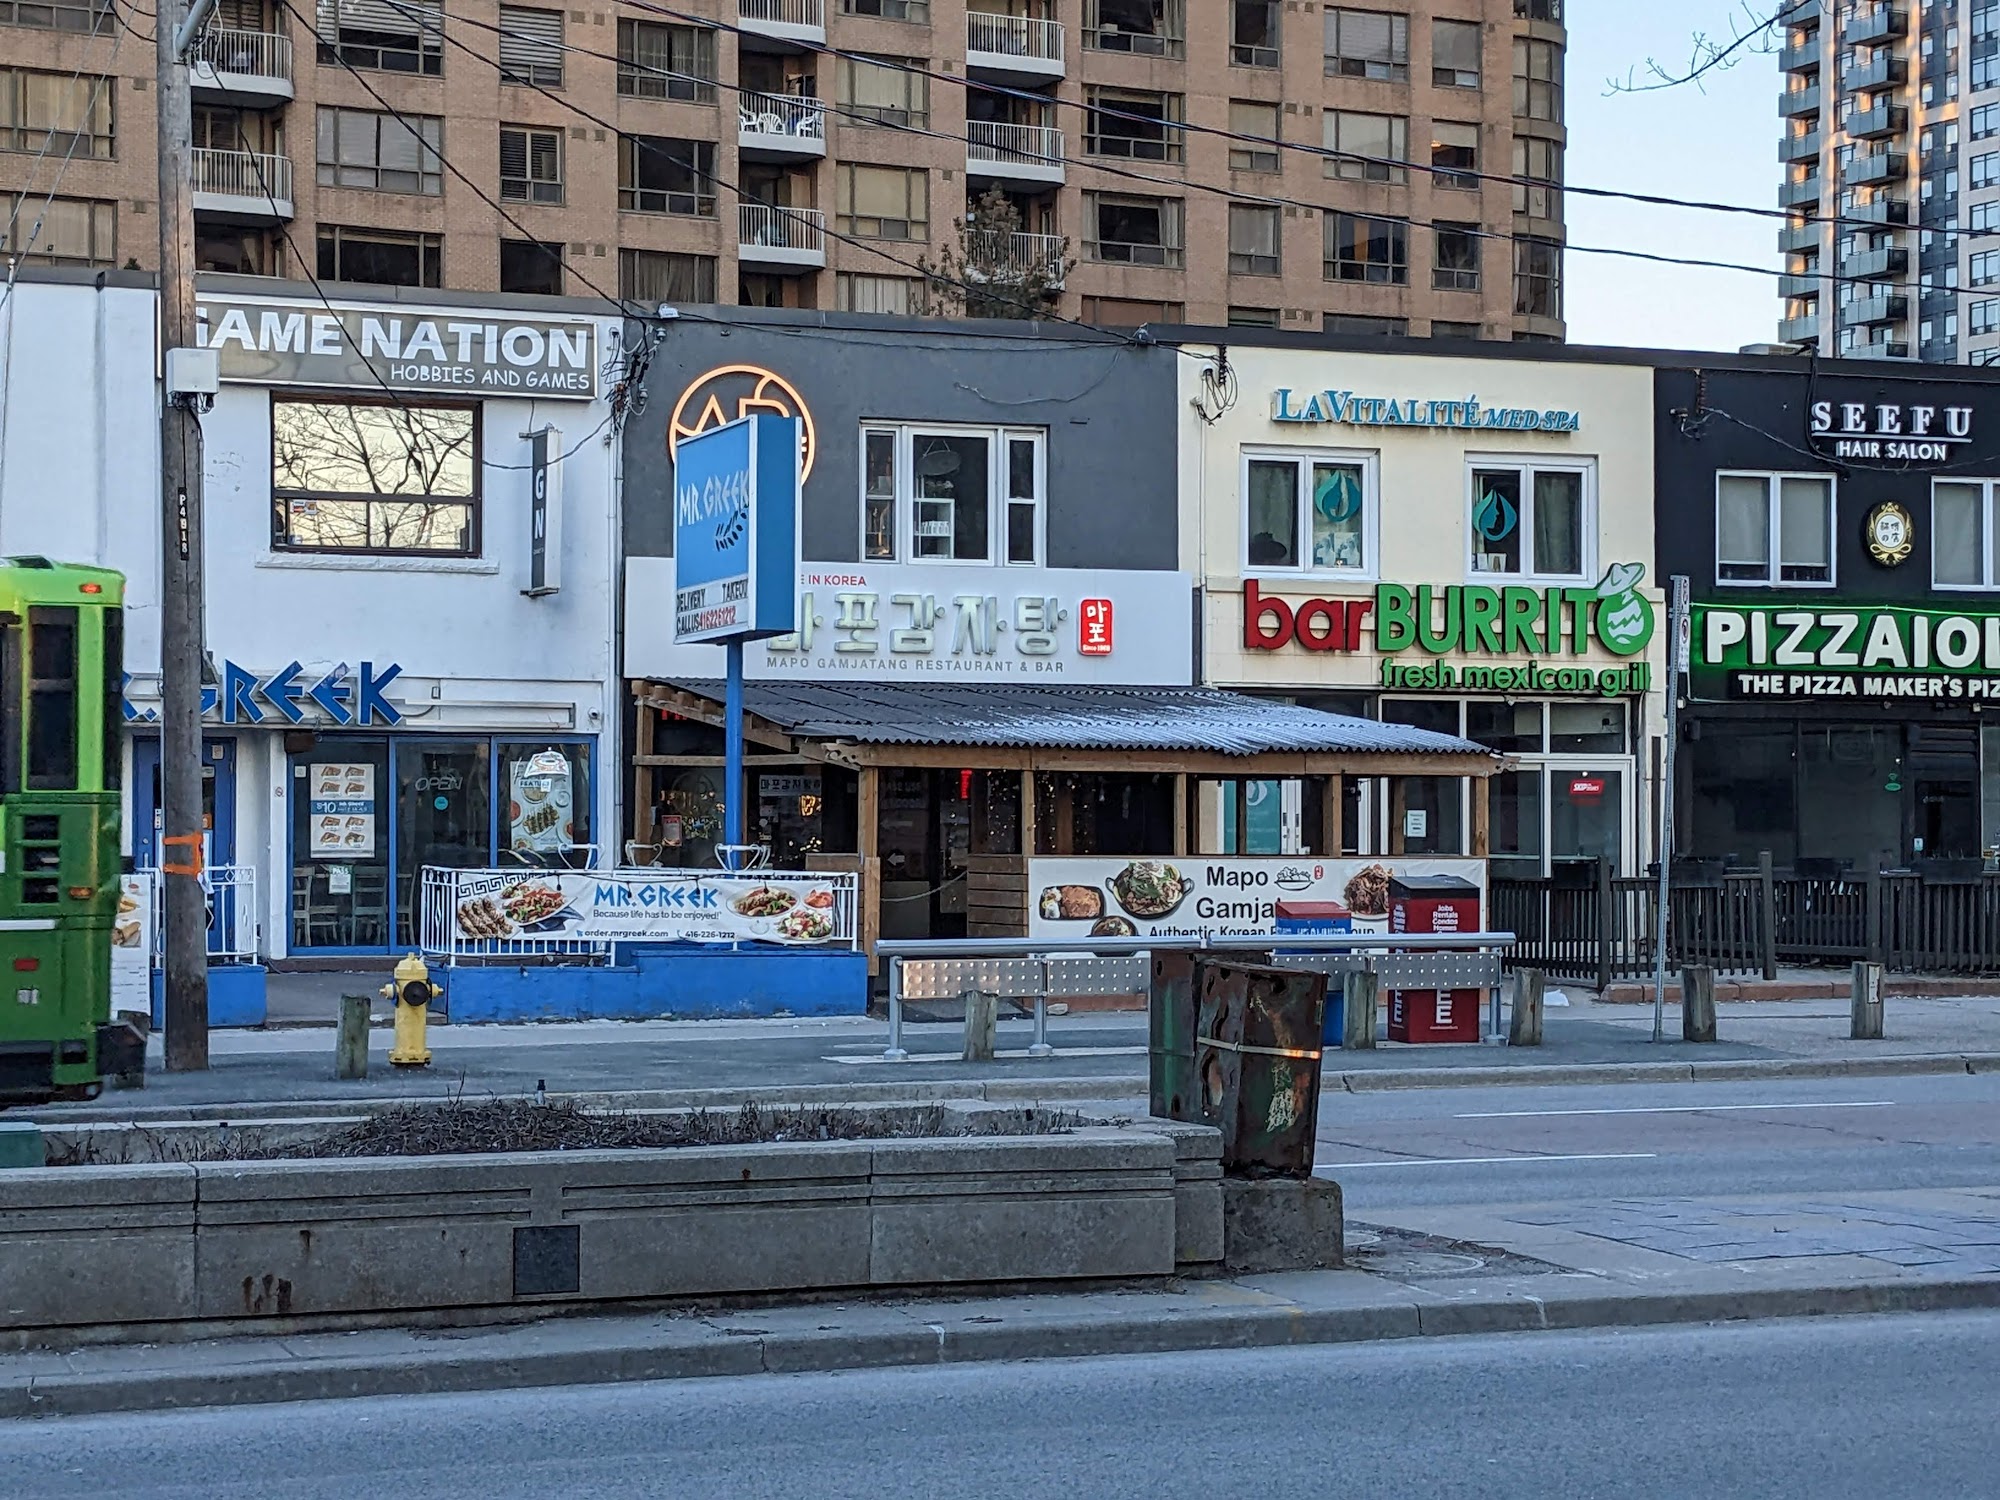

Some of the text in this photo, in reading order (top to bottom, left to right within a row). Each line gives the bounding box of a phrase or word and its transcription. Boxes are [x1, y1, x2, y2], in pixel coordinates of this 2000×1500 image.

[196, 307, 587, 368] AME NATION
[391, 364, 590, 389] HOBBIES AND GAMES
[1543, 410, 1580, 431] SPA
[1811, 402, 1972, 437] SEEFU
[1837, 441, 1946, 461] HAIR SALON
[679, 469, 749, 527] MR. GREEK
[808, 574, 820, 585] IN
[824, 575, 867, 586] KOREA
[766, 657, 1064, 673] MAPO GAMJATANG RESTAURANT & BAR
[1381, 657, 1652, 698] fresh mexican grill
[1738, 674, 1784, 694] THE
[1789, 676, 1857, 696] PIZZA
[1863, 675, 1963, 698] MAKER'S
[415, 776, 463, 791] OPEN
[1206, 866, 1268, 892] Mapo
[594, 883, 718, 909] MR. GREEK
[593, 909, 629, 918] Because
[630, 910, 643, 919] life
[644, 911, 659, 919] has
[661, 911, 669, 919] to
[671, 910, 682, 919] be
[1196, 897, 1274, 924] Gamja
[1432, 911, 1459, 919] Rentals
[1438, 904, 1454, 912] Jobs
[584, 929, 735, 939] order.mrgreek.com 416-226-1212
